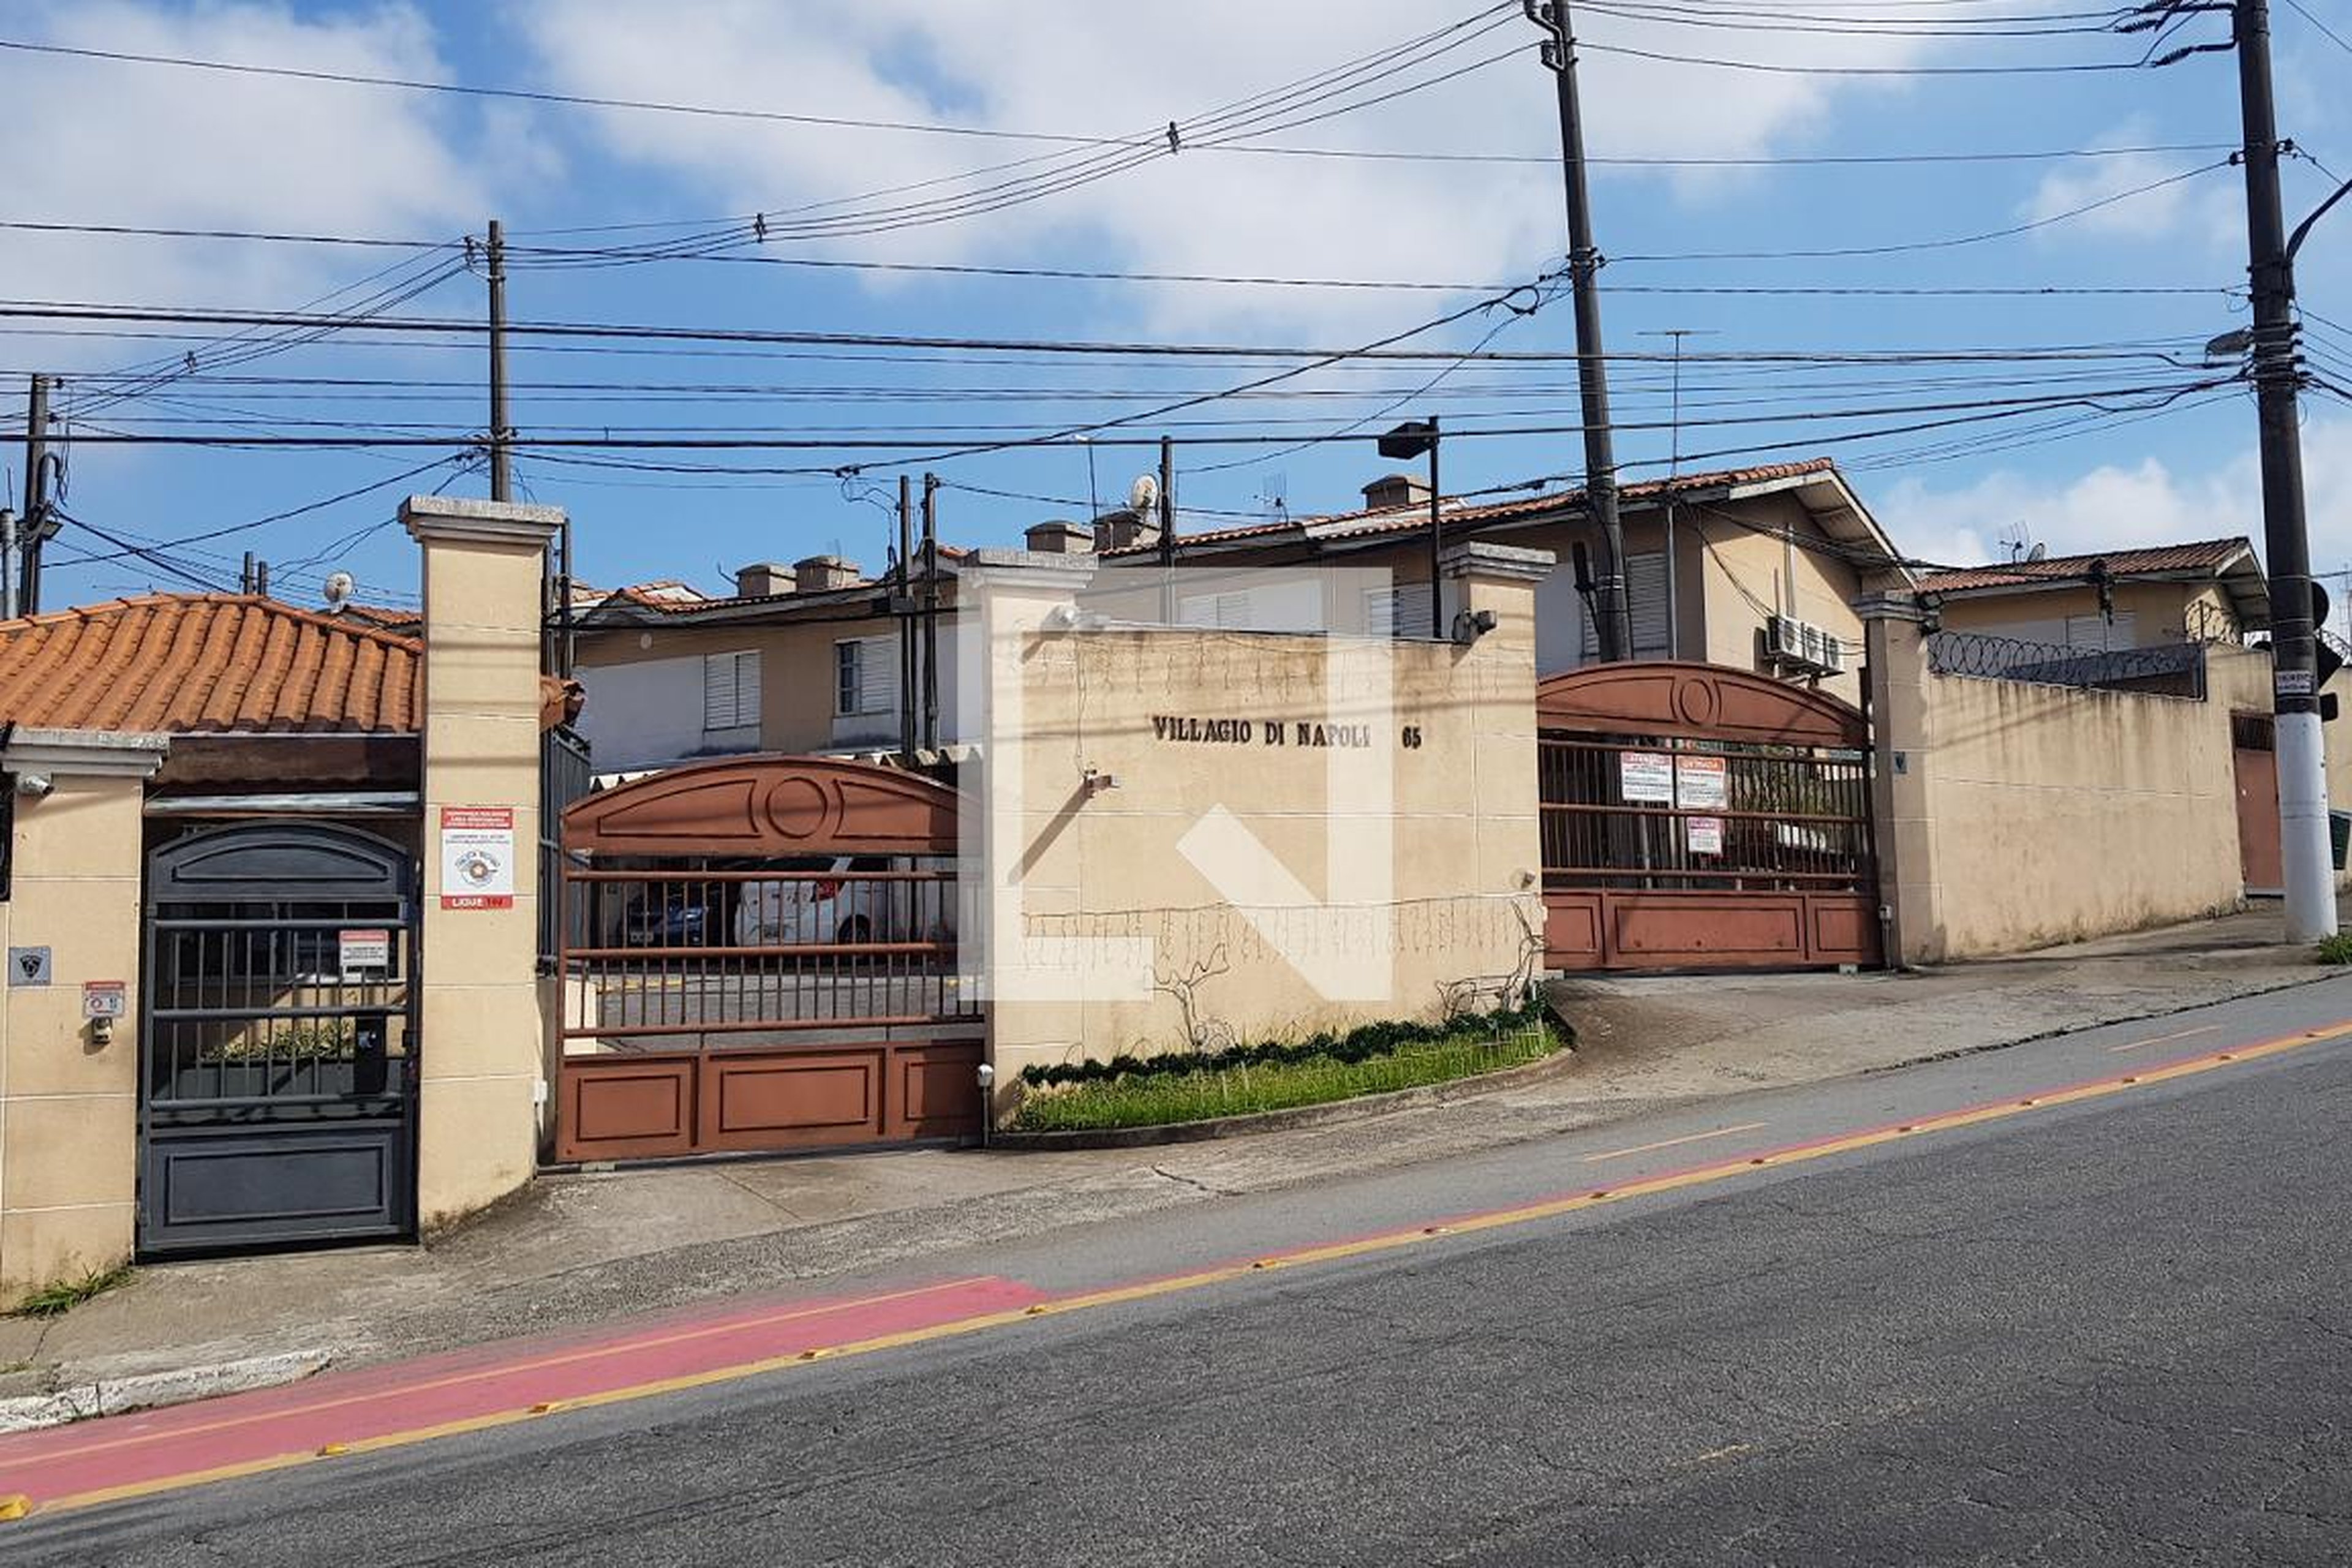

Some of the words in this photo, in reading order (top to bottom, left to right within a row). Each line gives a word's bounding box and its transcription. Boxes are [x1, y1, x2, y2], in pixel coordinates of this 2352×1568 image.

[1152, 715, 1252, 744] VILLAGIO
[1265, 722, 1285, 746] DI
[1297, 723, 1371, 748] NAPOLI
[1403, 726, 1422, 748] 65
